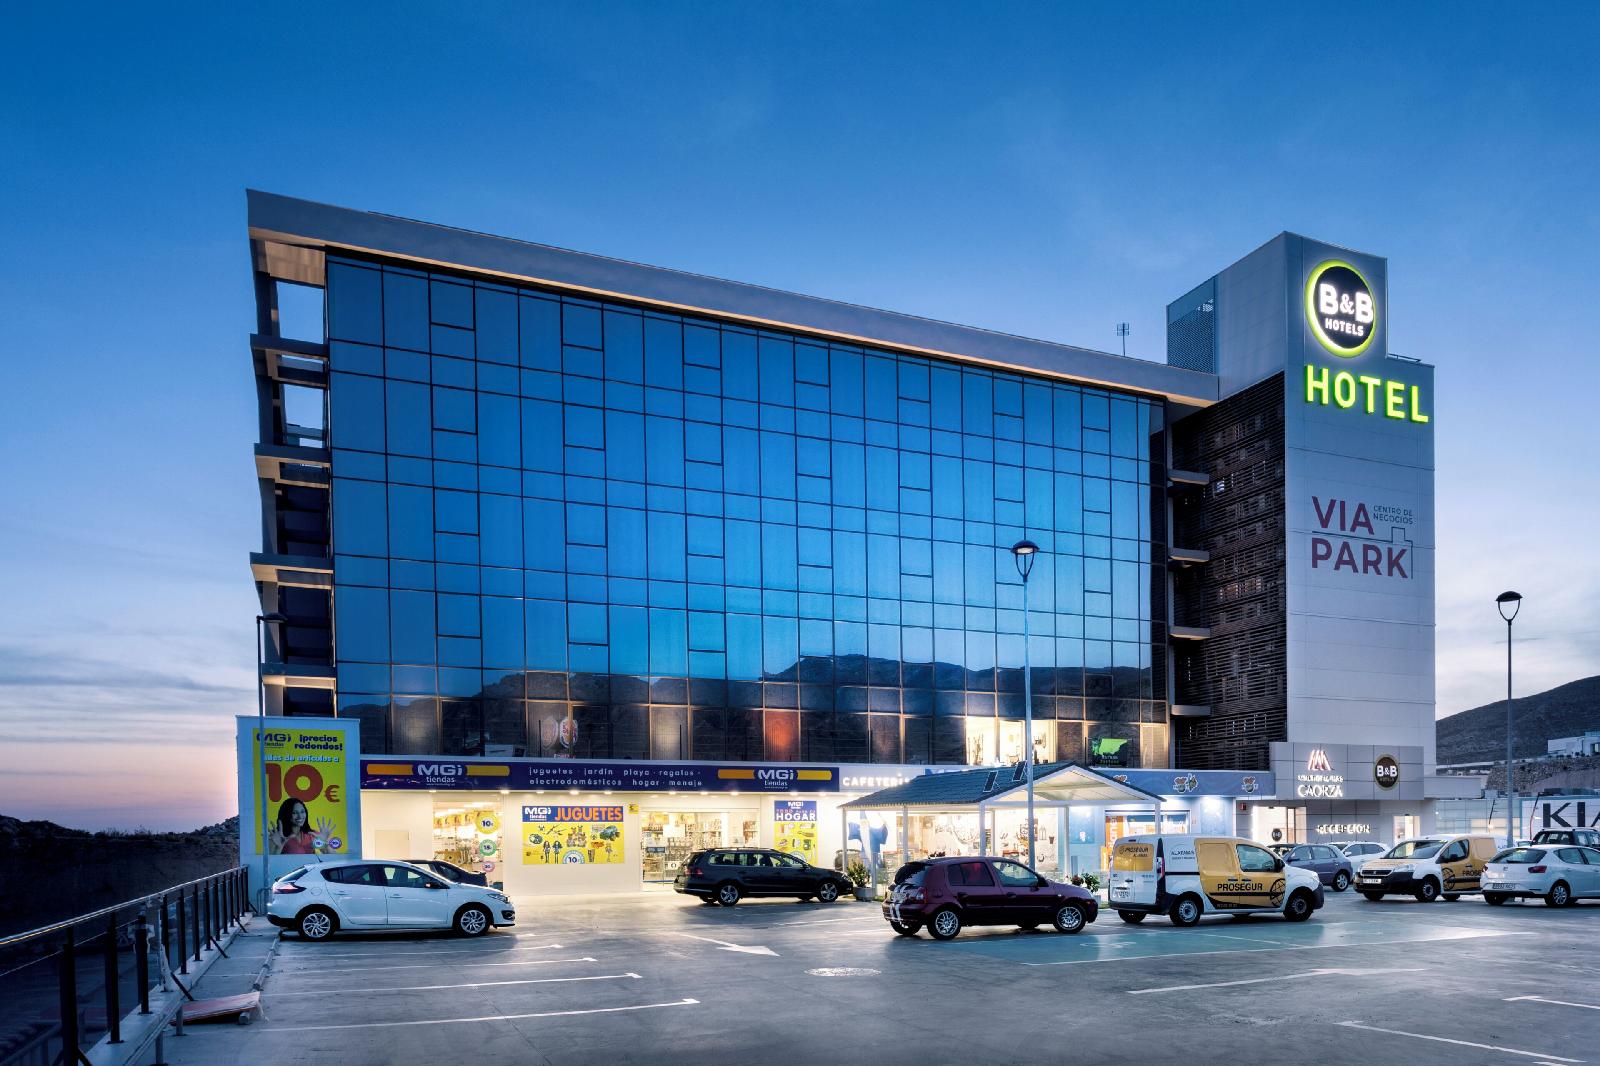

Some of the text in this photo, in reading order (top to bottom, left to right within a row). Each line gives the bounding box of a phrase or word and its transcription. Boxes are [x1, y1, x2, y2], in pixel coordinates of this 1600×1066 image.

[1319, 283, 1374, 323] B&B
[1325, 317, 1364, 336] HOTELS
[1305, 364, 1429, 423] HOTEL
[1312, 495, 1375, 535] VIA
[1374, 505, 1413, 517] CENTRO DE
[1373, 512, 1414, 525] NEGOCIOS
[1312, 537, 1408, 579] PARK
[294, 742, 343, 751] redondos!
[417, 764, 463, 776] MGi
[529, 766, 574, 777] juguetes
[623, 768, 650, 778] playa
[658, 769, 694, 779] regalos
[758, 769, 794, 780] MGi
[1376, 765, 1398, 778] B&B
[426, 775, 456, 784] tiendas
[529, 777, 702, 789] electrodomésticos hogar menaje
[555, 807, 622, 821] JUGUETES
[776, 813, 816, 821] HOGAR
[1217, 883, 1263, 892] PROSEGUR
